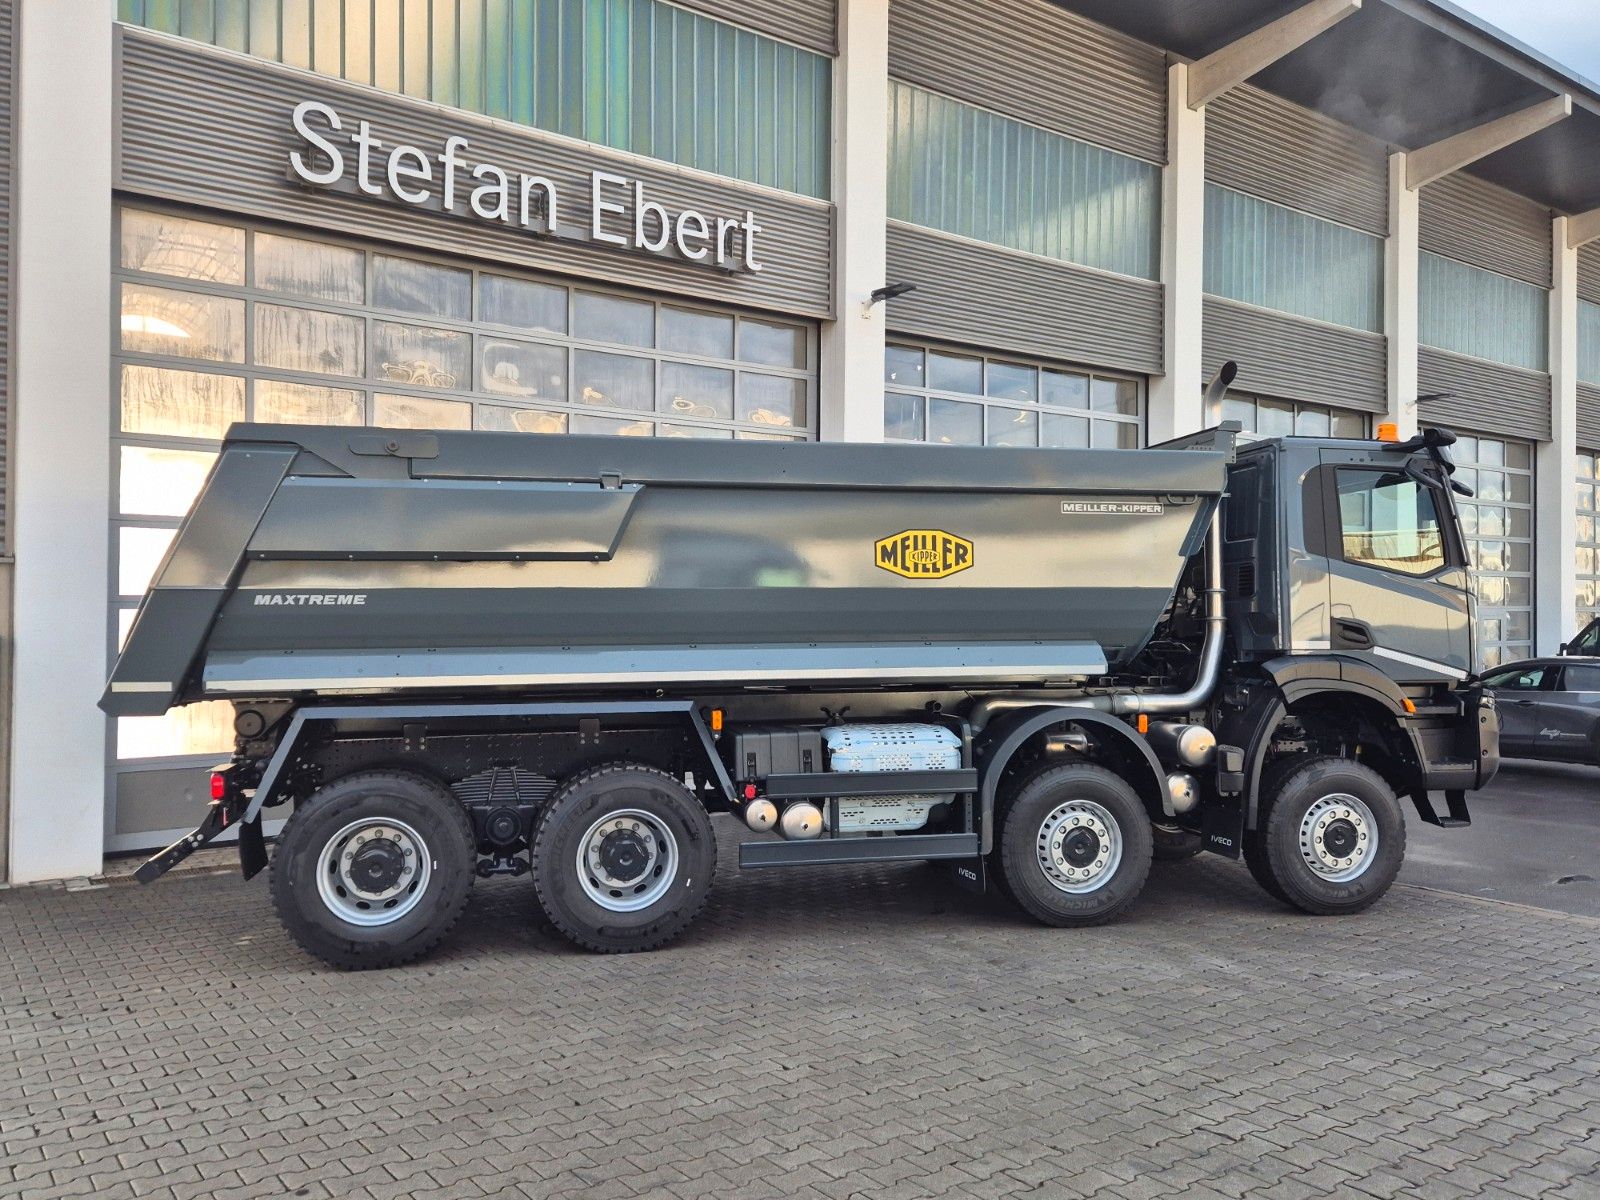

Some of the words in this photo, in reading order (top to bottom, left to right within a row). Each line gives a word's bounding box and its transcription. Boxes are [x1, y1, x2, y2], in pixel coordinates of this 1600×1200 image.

[288, 101, 558, 232] Stefan
[590, 169, 763, 272] Ebert
[1062, 502, 1162, 514] MEILLER-KIPPER
[880, 534, 969, 573] MEILLER
[912, 550, 938, 563] KIPPER
[253, 594, 368, 606] MAXTREME
[1210, 834, 1233, 847] IVECO
[958, 867, 977, 881] IVECO
